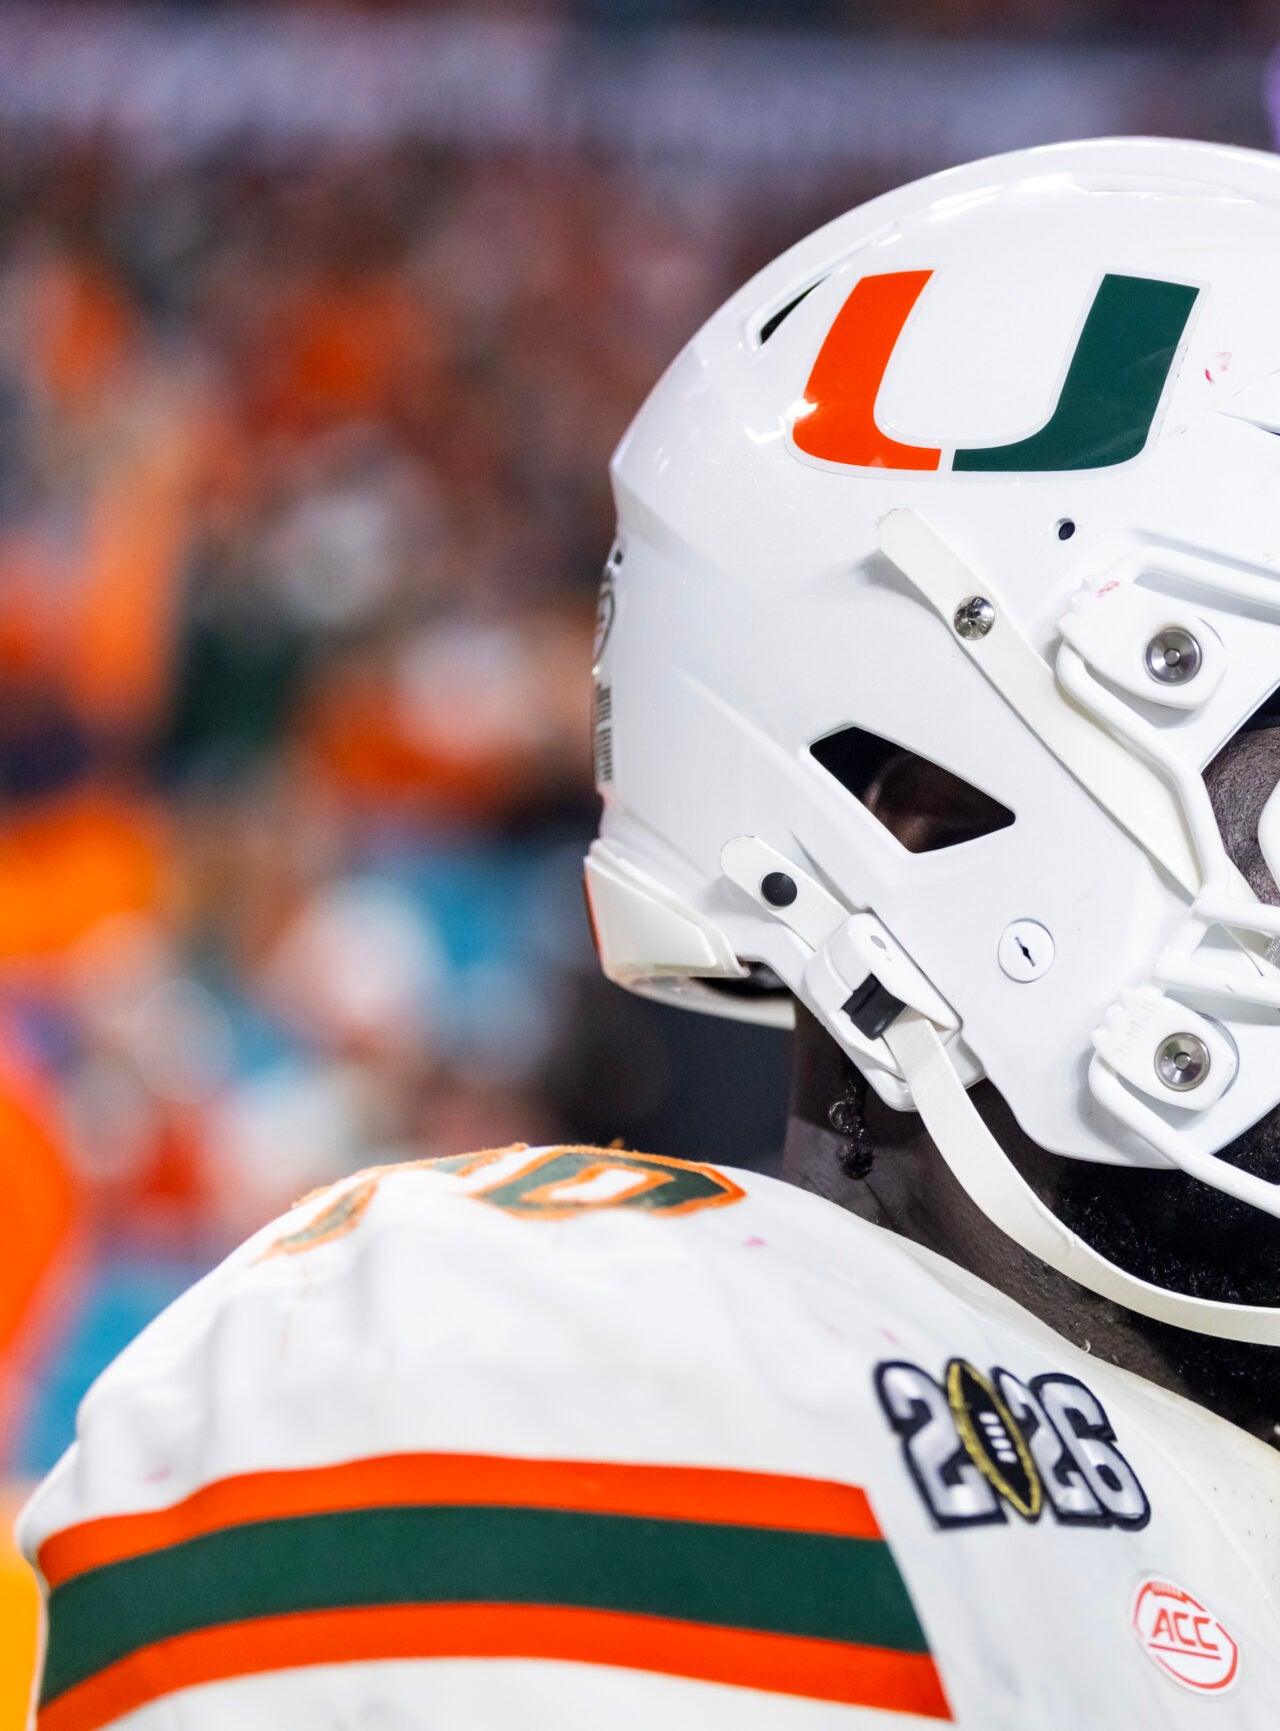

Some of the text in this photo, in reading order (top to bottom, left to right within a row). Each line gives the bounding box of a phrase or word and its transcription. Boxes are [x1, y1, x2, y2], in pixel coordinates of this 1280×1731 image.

[792, 269, 1200, 472] U
[874, 1357, 1152, 1532] 2026
[1151, 1608, 1220, 1652] ACC
